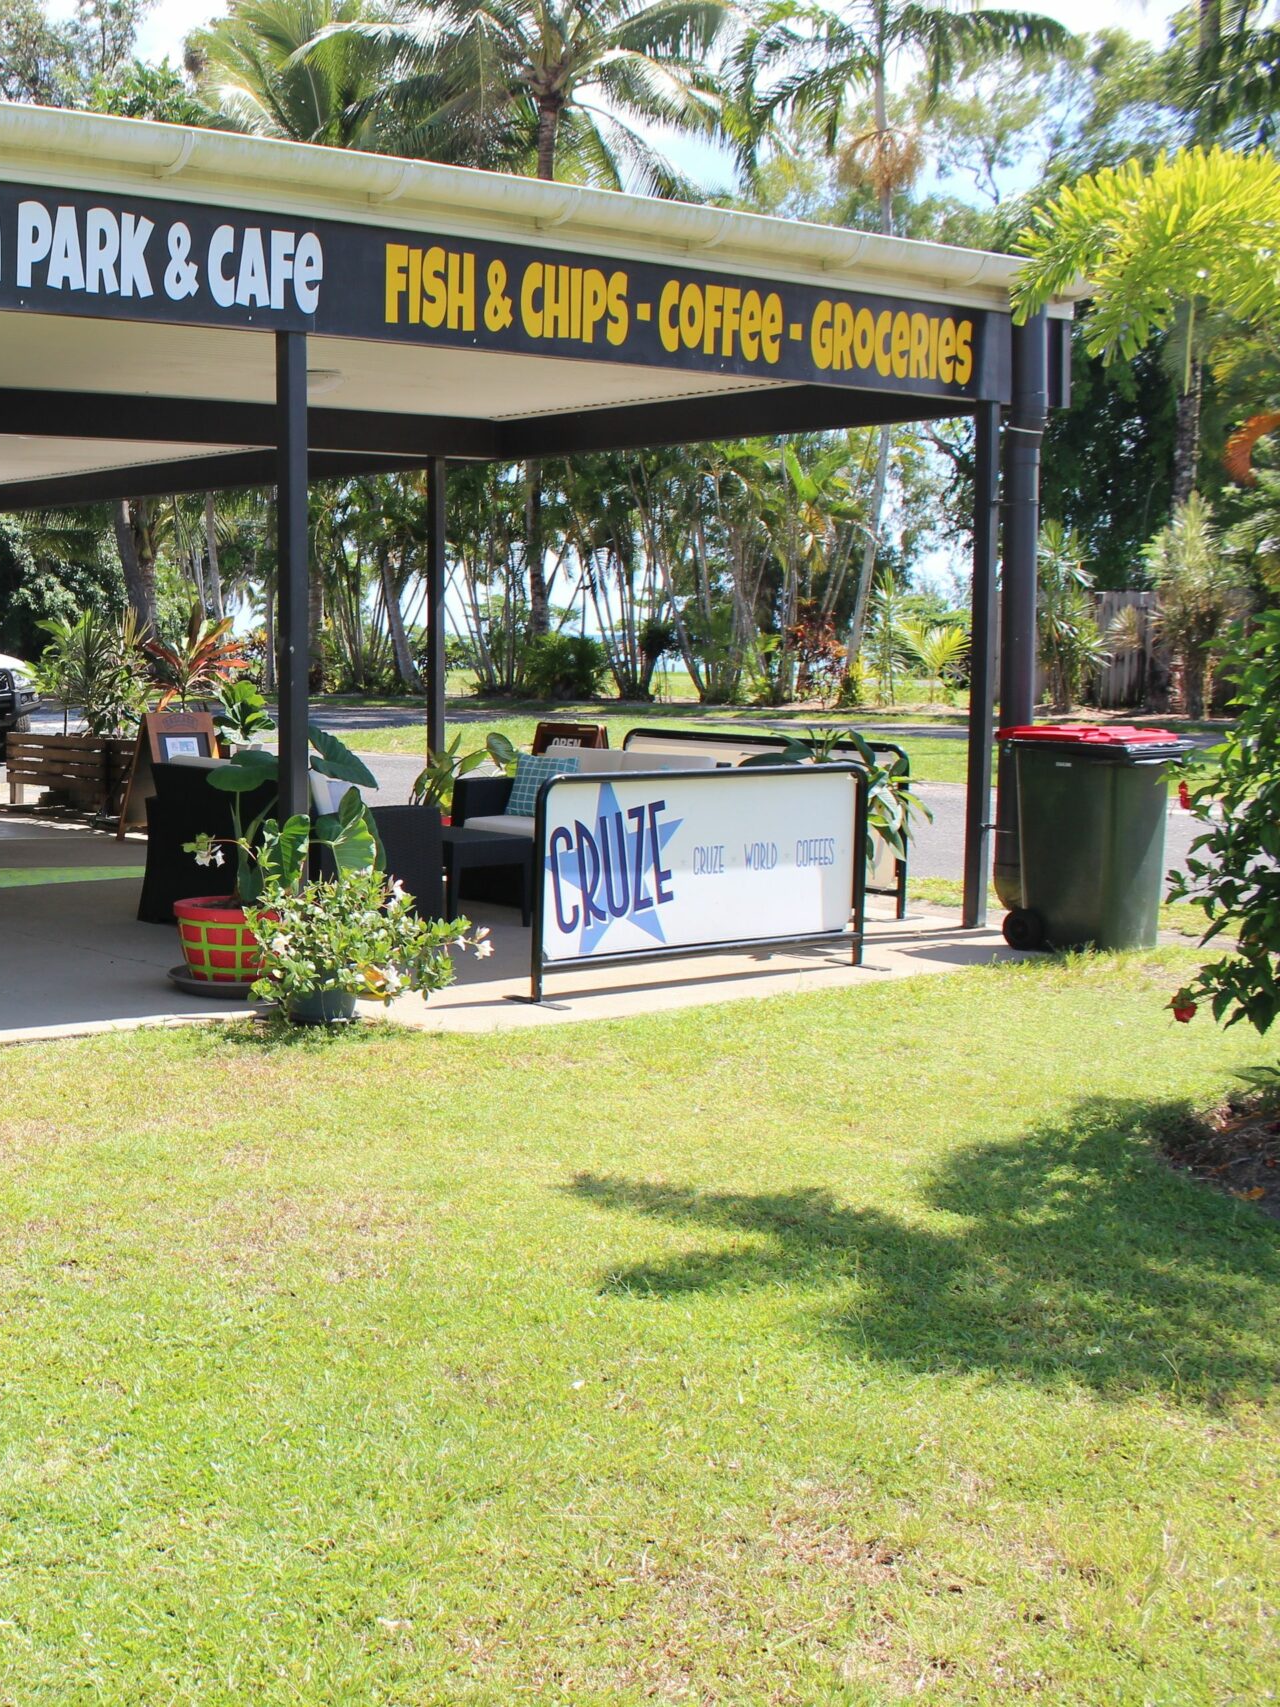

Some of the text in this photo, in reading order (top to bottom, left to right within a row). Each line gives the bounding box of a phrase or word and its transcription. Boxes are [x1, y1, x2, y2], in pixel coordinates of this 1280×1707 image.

[16, 200, 156, 299] PARK
[163, 221, 200, 301] &
[384, 242, 476, 332] FISH
[483, 258, 513, 332] &
[520, 261, 629, 346] CHIPS
[549, 799, 674, 935] CRUZE
[692, 837, 836, 876] CRUZE WORLD COFFEES
